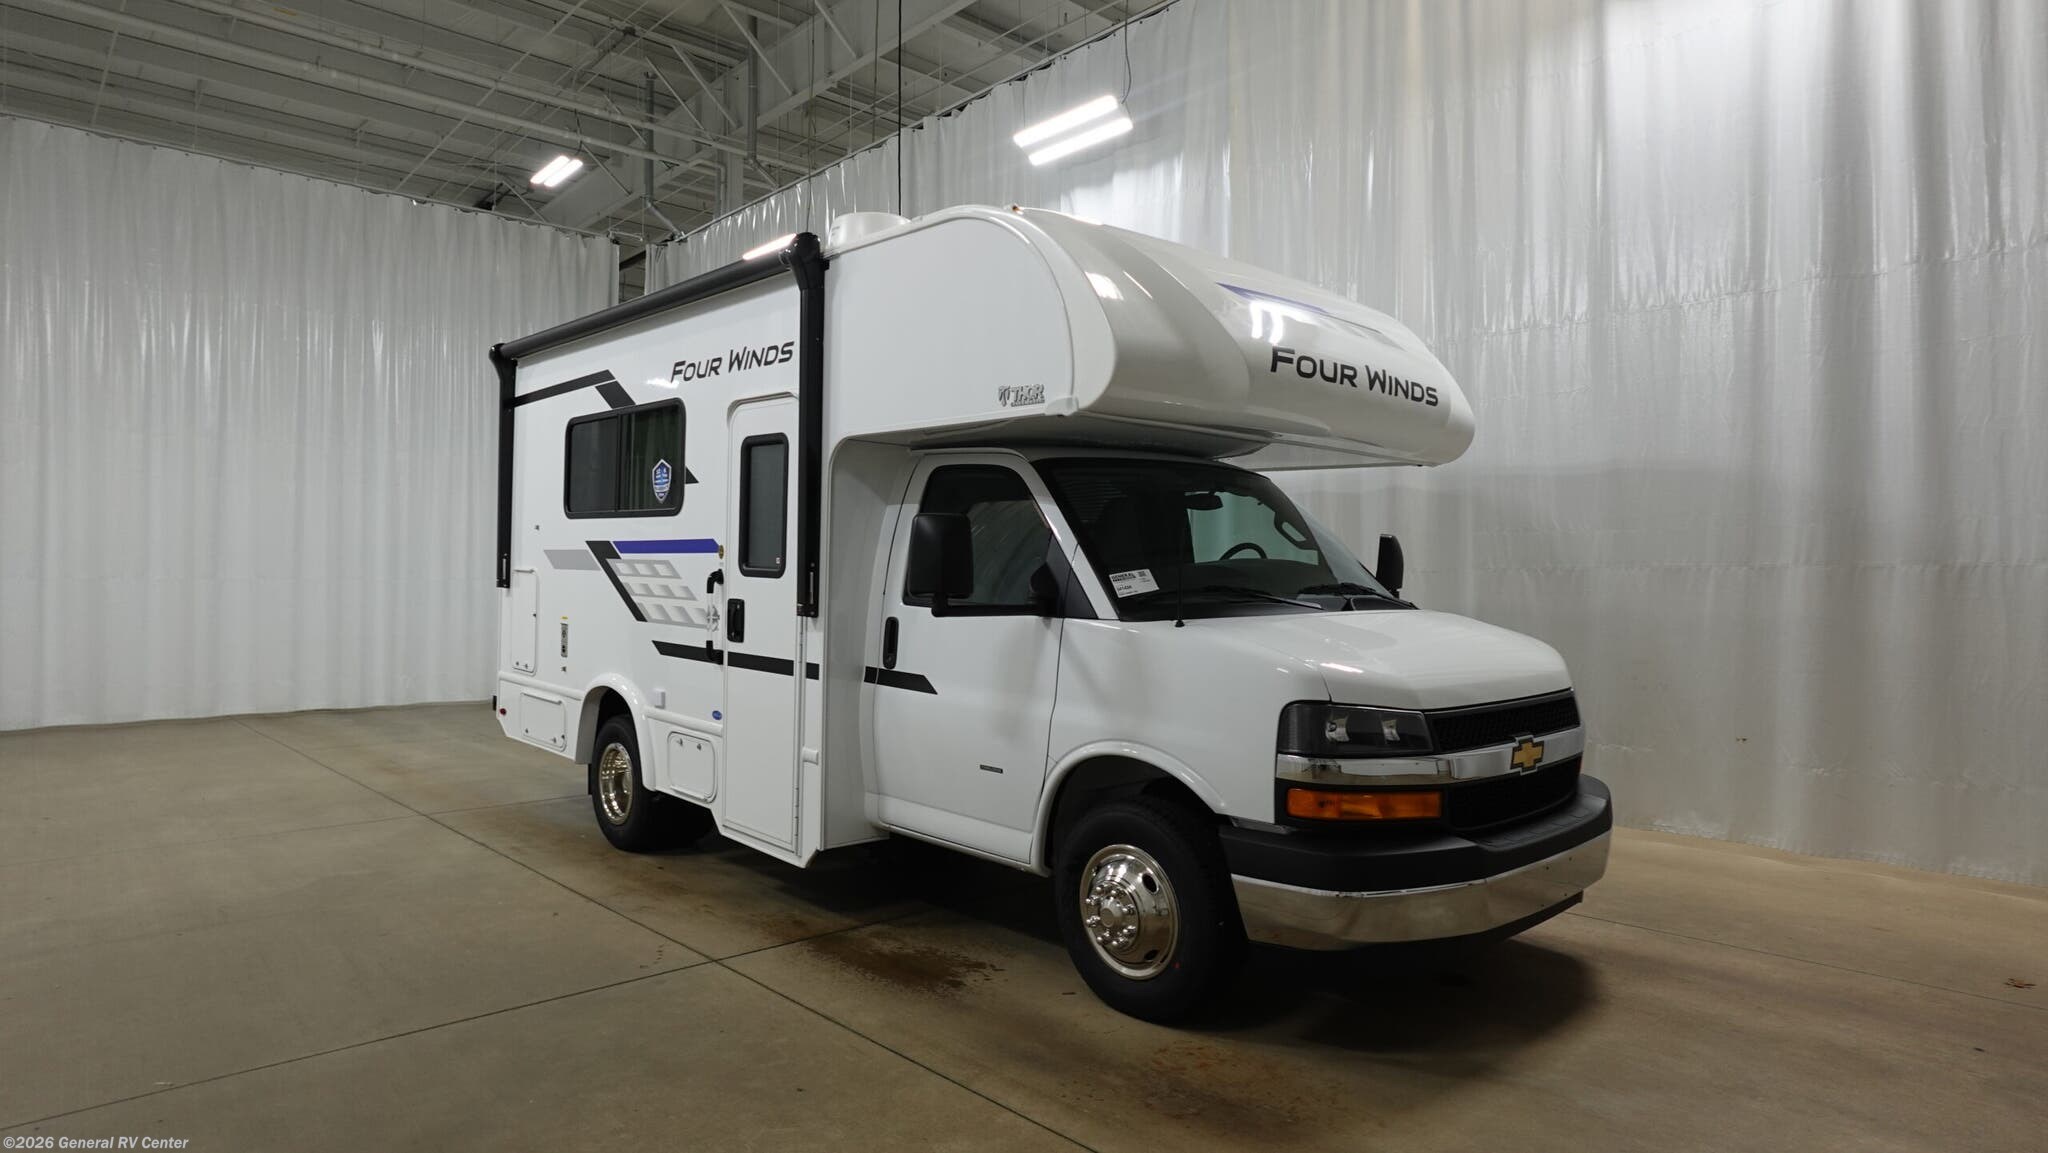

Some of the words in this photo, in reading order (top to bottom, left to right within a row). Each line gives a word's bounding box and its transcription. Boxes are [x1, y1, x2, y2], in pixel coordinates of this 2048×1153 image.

[671, 357, 722, 383] FOUR
[728, 341, 795, 373] WINDS
[1270, 346, 1358, 388] FOUR
[1365, 364, 1439, 406] WINDS
